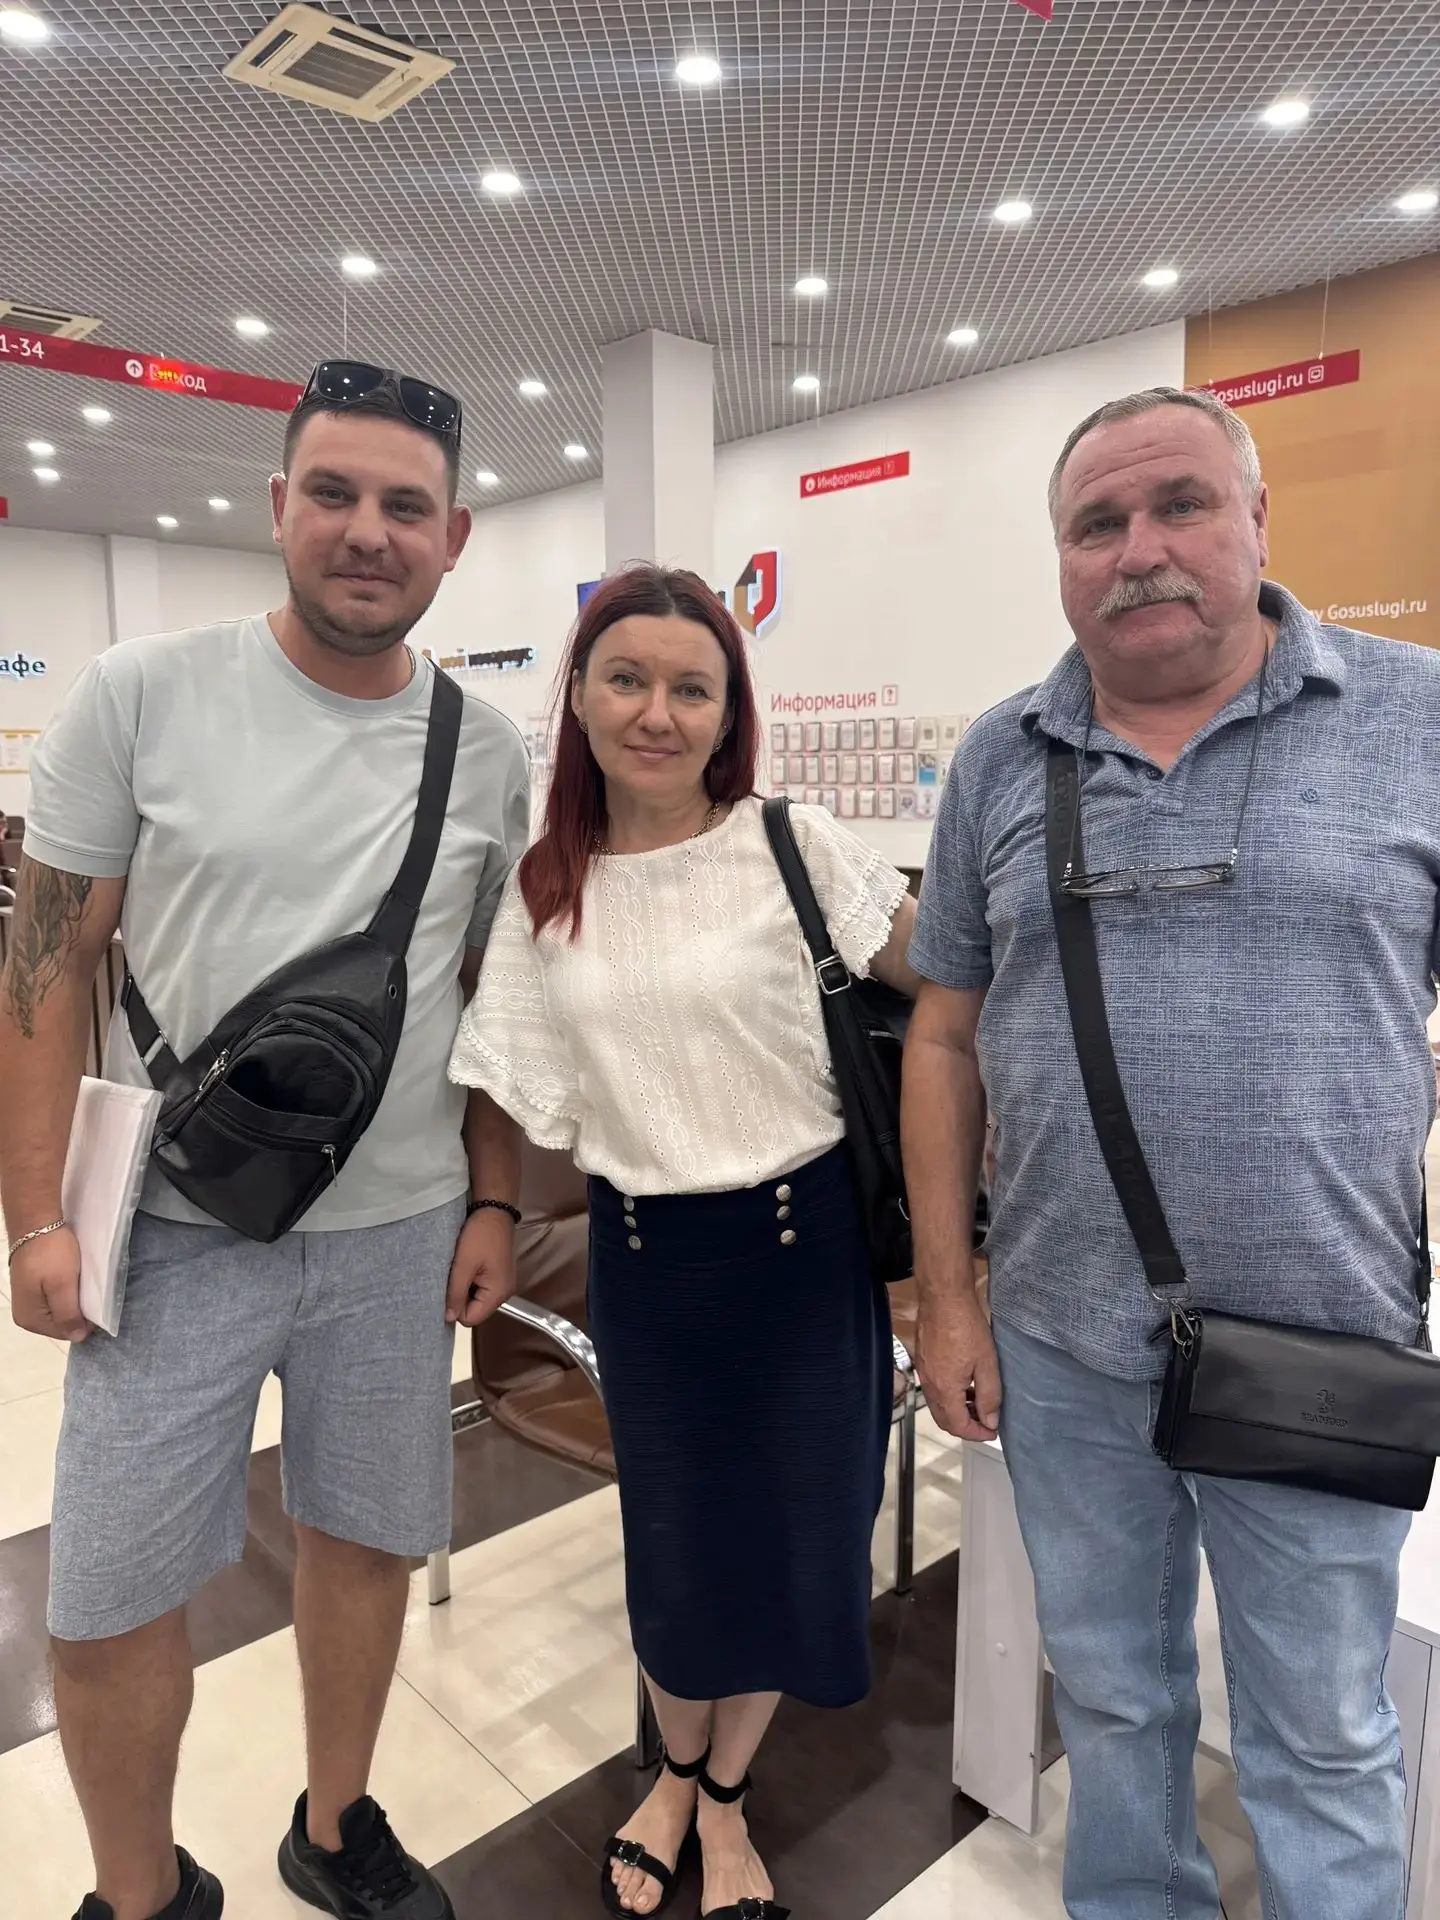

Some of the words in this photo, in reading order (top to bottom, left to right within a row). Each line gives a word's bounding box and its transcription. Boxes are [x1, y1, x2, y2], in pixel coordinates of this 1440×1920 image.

[149, 363, 207, 392] Вход
[817, 465, 882, 488] Информация
[1327, 599, 1427, 622] Gosuslugi.ru
[770, 691, 877, 715] Информация
